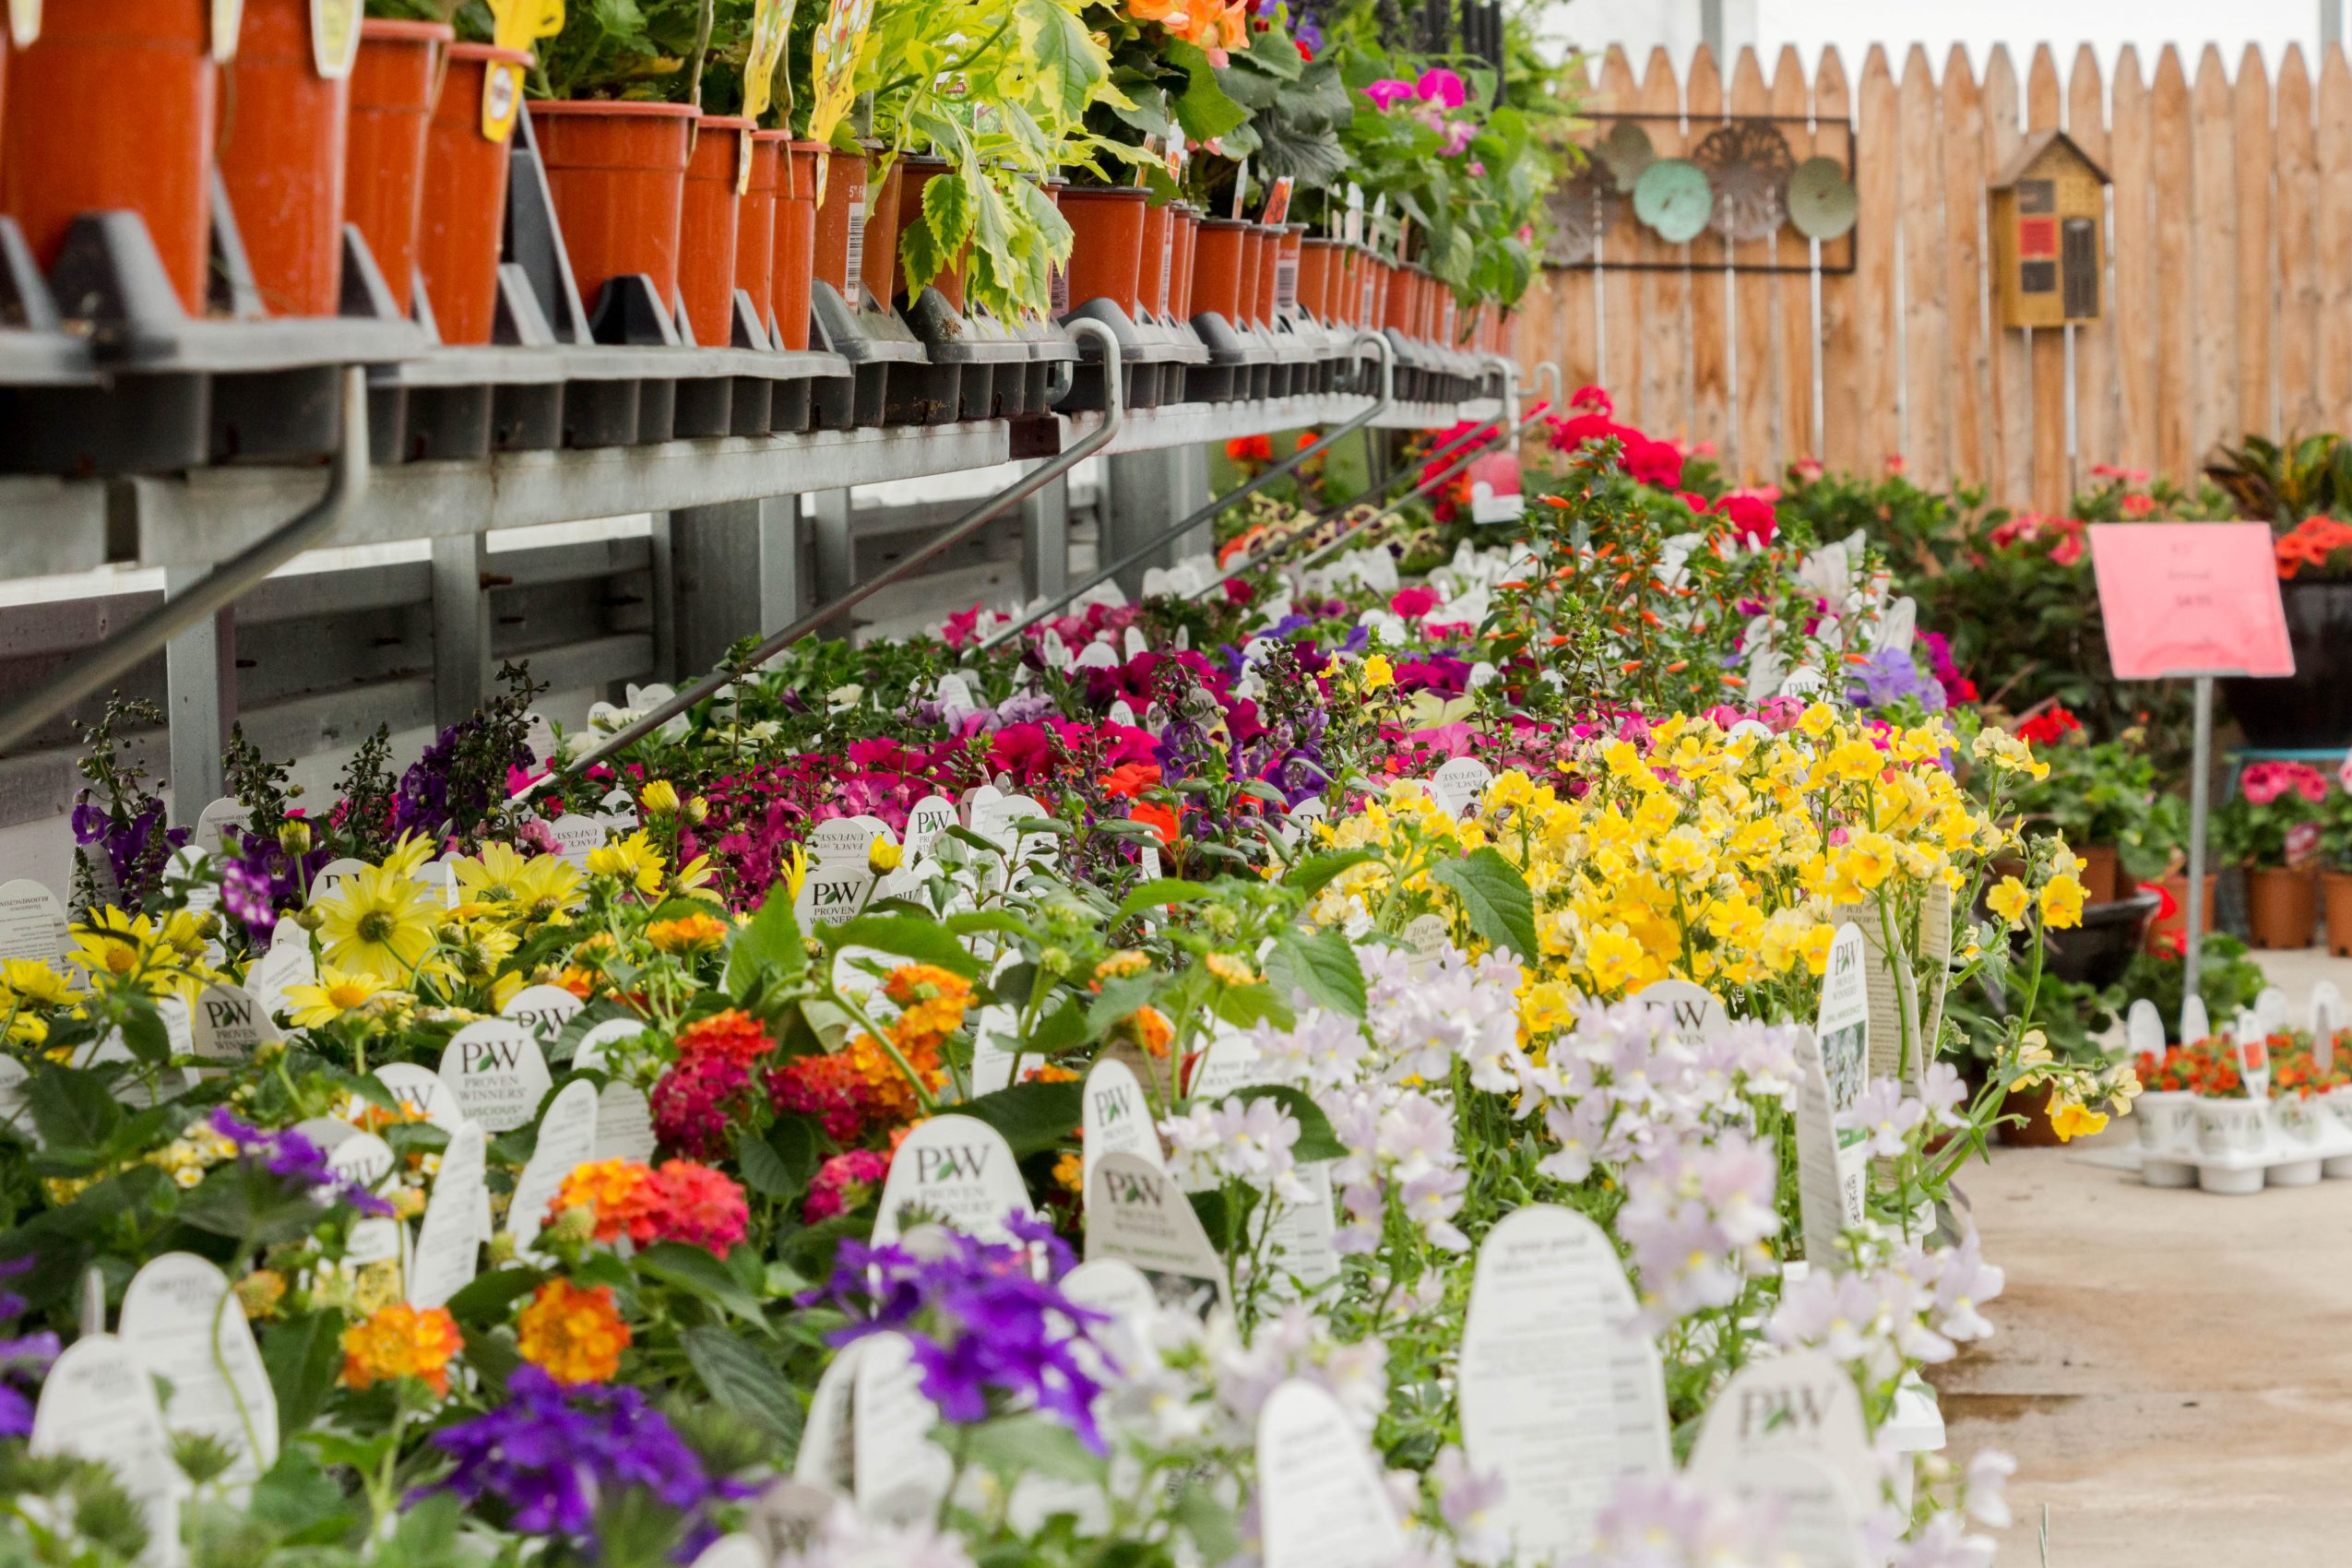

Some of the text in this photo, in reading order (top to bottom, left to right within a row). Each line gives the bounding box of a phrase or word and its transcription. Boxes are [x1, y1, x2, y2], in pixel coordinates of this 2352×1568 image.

[917, 811, 951, 834] PW
[834, 843, 863, 851] FANCY,
[812, 881, 862, 906] PW
[814, 907, 856, 916] PROVEN
[1835, 939, 1860, 976] PW
[204, 998, 253, 1028] PW
[460, 1039, 524, 1075] PW
[464, 1075, 519, 1088] PROVEN
[1094, 1083, 1133, 1128] PW
[914, 1144, 992, 1183] PW
[1103, 1170, 1165, 1208] PW
